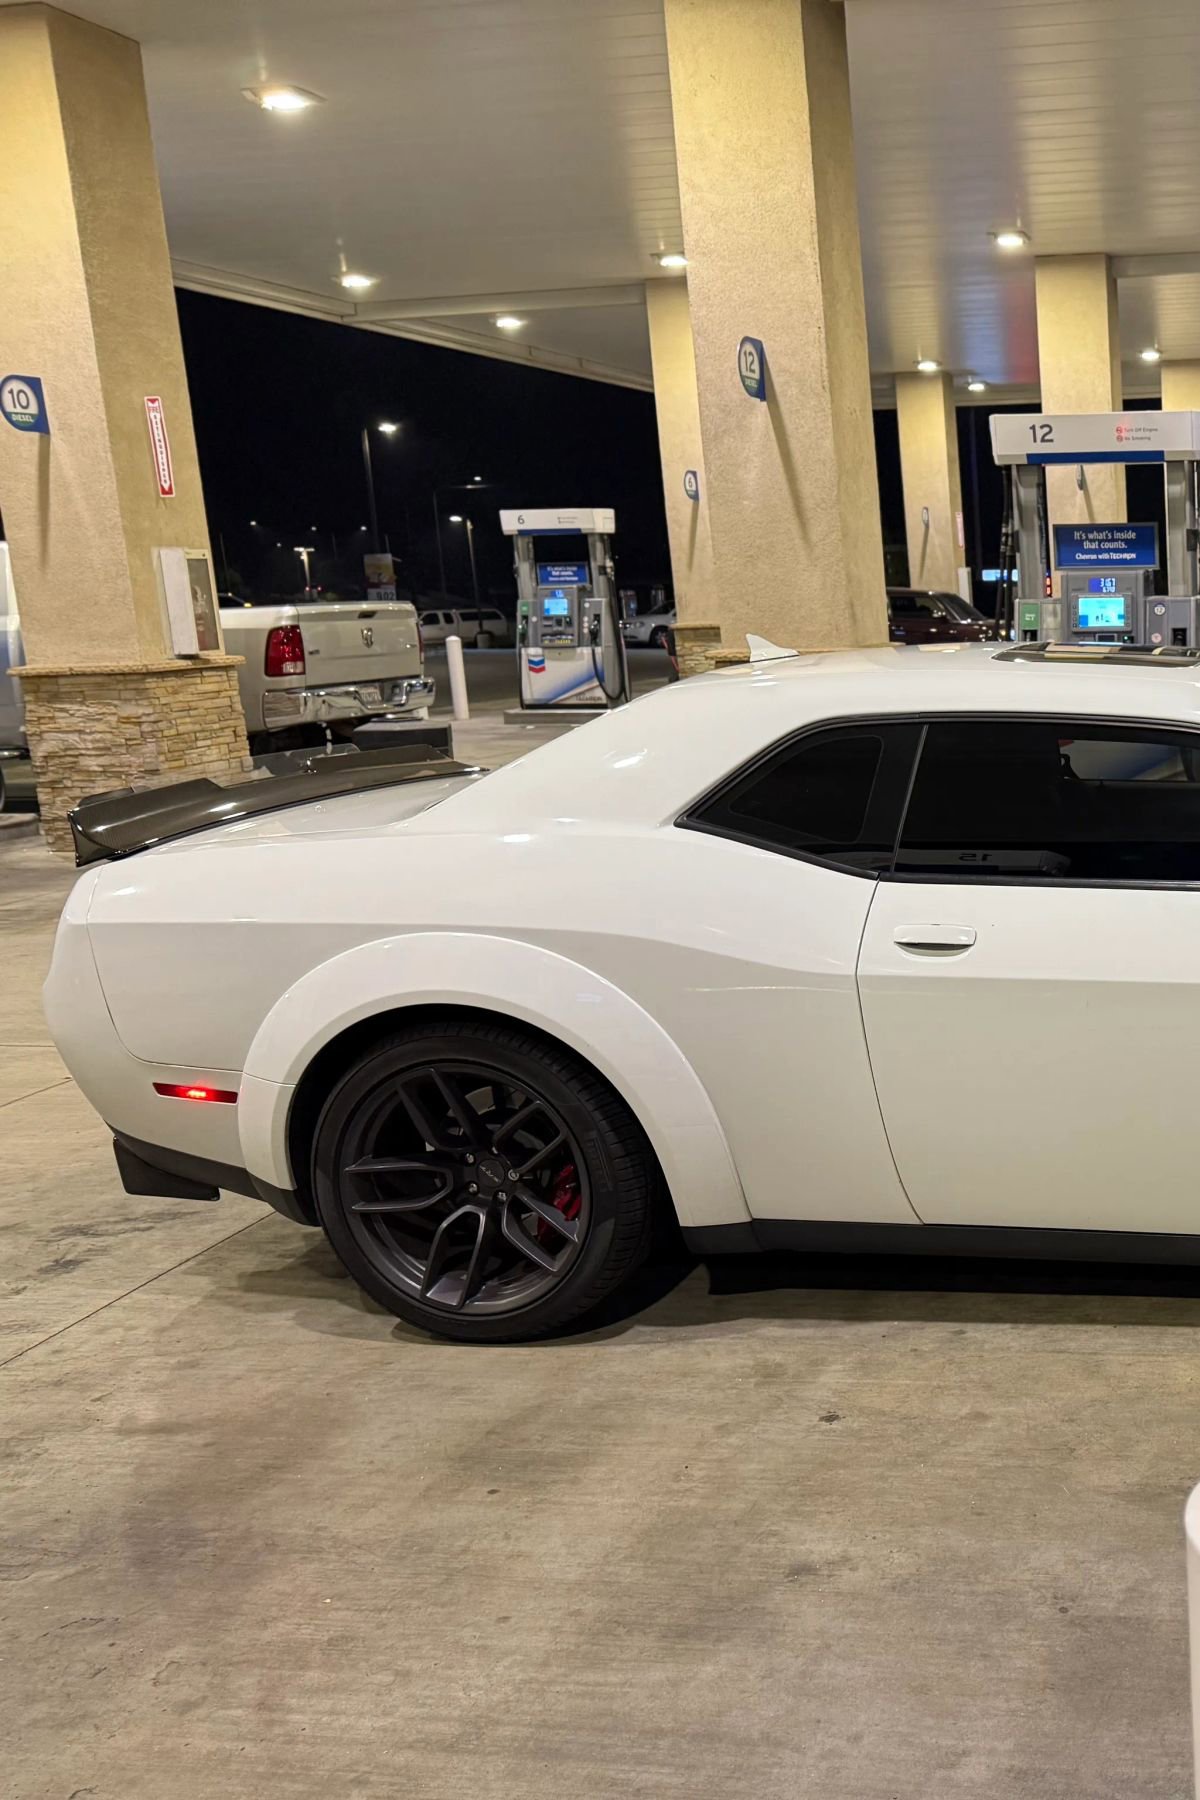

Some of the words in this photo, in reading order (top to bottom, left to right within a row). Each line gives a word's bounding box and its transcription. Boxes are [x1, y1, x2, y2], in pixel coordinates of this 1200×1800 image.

[743, 350, 756, 374] 12
[8, 388, 30, 410] 10
[1029, 424, 1054, 443] 12
[687, 476, 693, 488] 6
[517, 514, 525, 525] 6
[1074, 530, 1086, 539] It's
[1088, 530, 1112, 540] what's
[1113, 530, 1136, 539] inside
[1083, 541, 1098, 549] that
[1100, 541, 1128, 549] counts.
